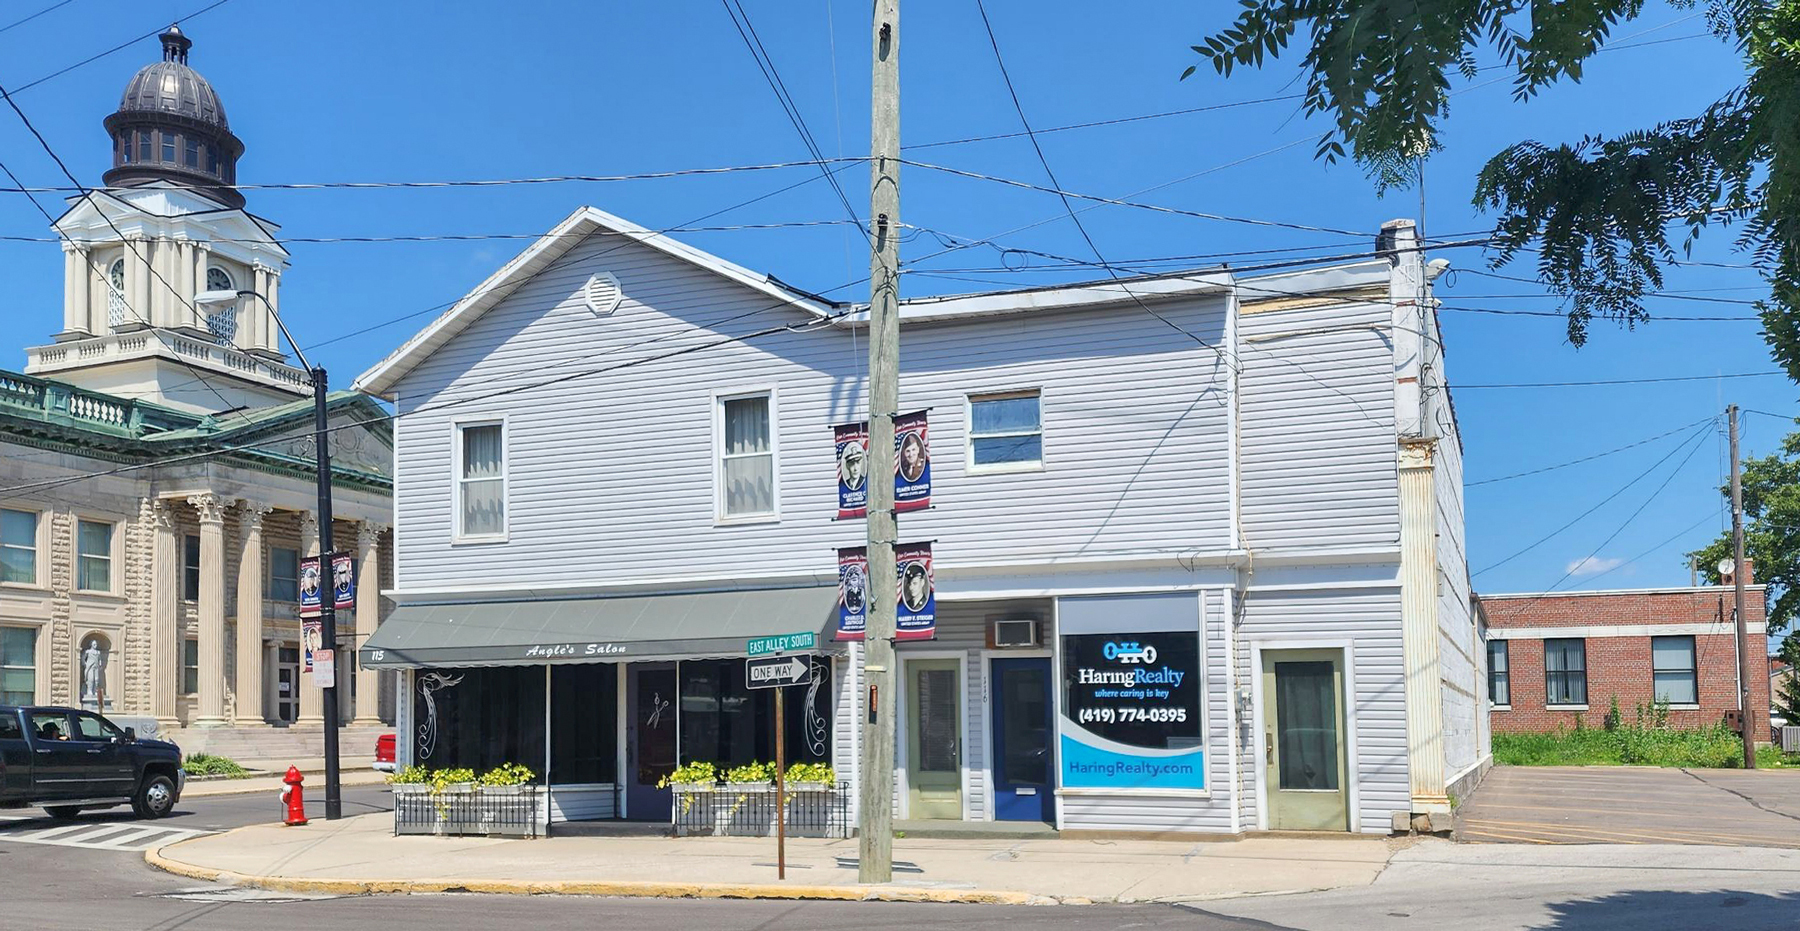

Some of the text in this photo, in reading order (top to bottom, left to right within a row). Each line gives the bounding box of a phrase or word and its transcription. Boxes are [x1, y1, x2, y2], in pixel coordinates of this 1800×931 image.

[585, 644, 626, 654] Salon
[750, 634, 812, 653] EAST ALLEY SOUTH
[372, 651, 384, 660] 115
[754, 665, 792, 679] ONE WAY
[1079, 666, 1184, 687] HaringRealty
[1095, 689, 1169, 699] where caring is key
[1079, 708, 1186, 724] (419) 774-0395
[1070, 762, 1193, 777] HaringRealty.com
